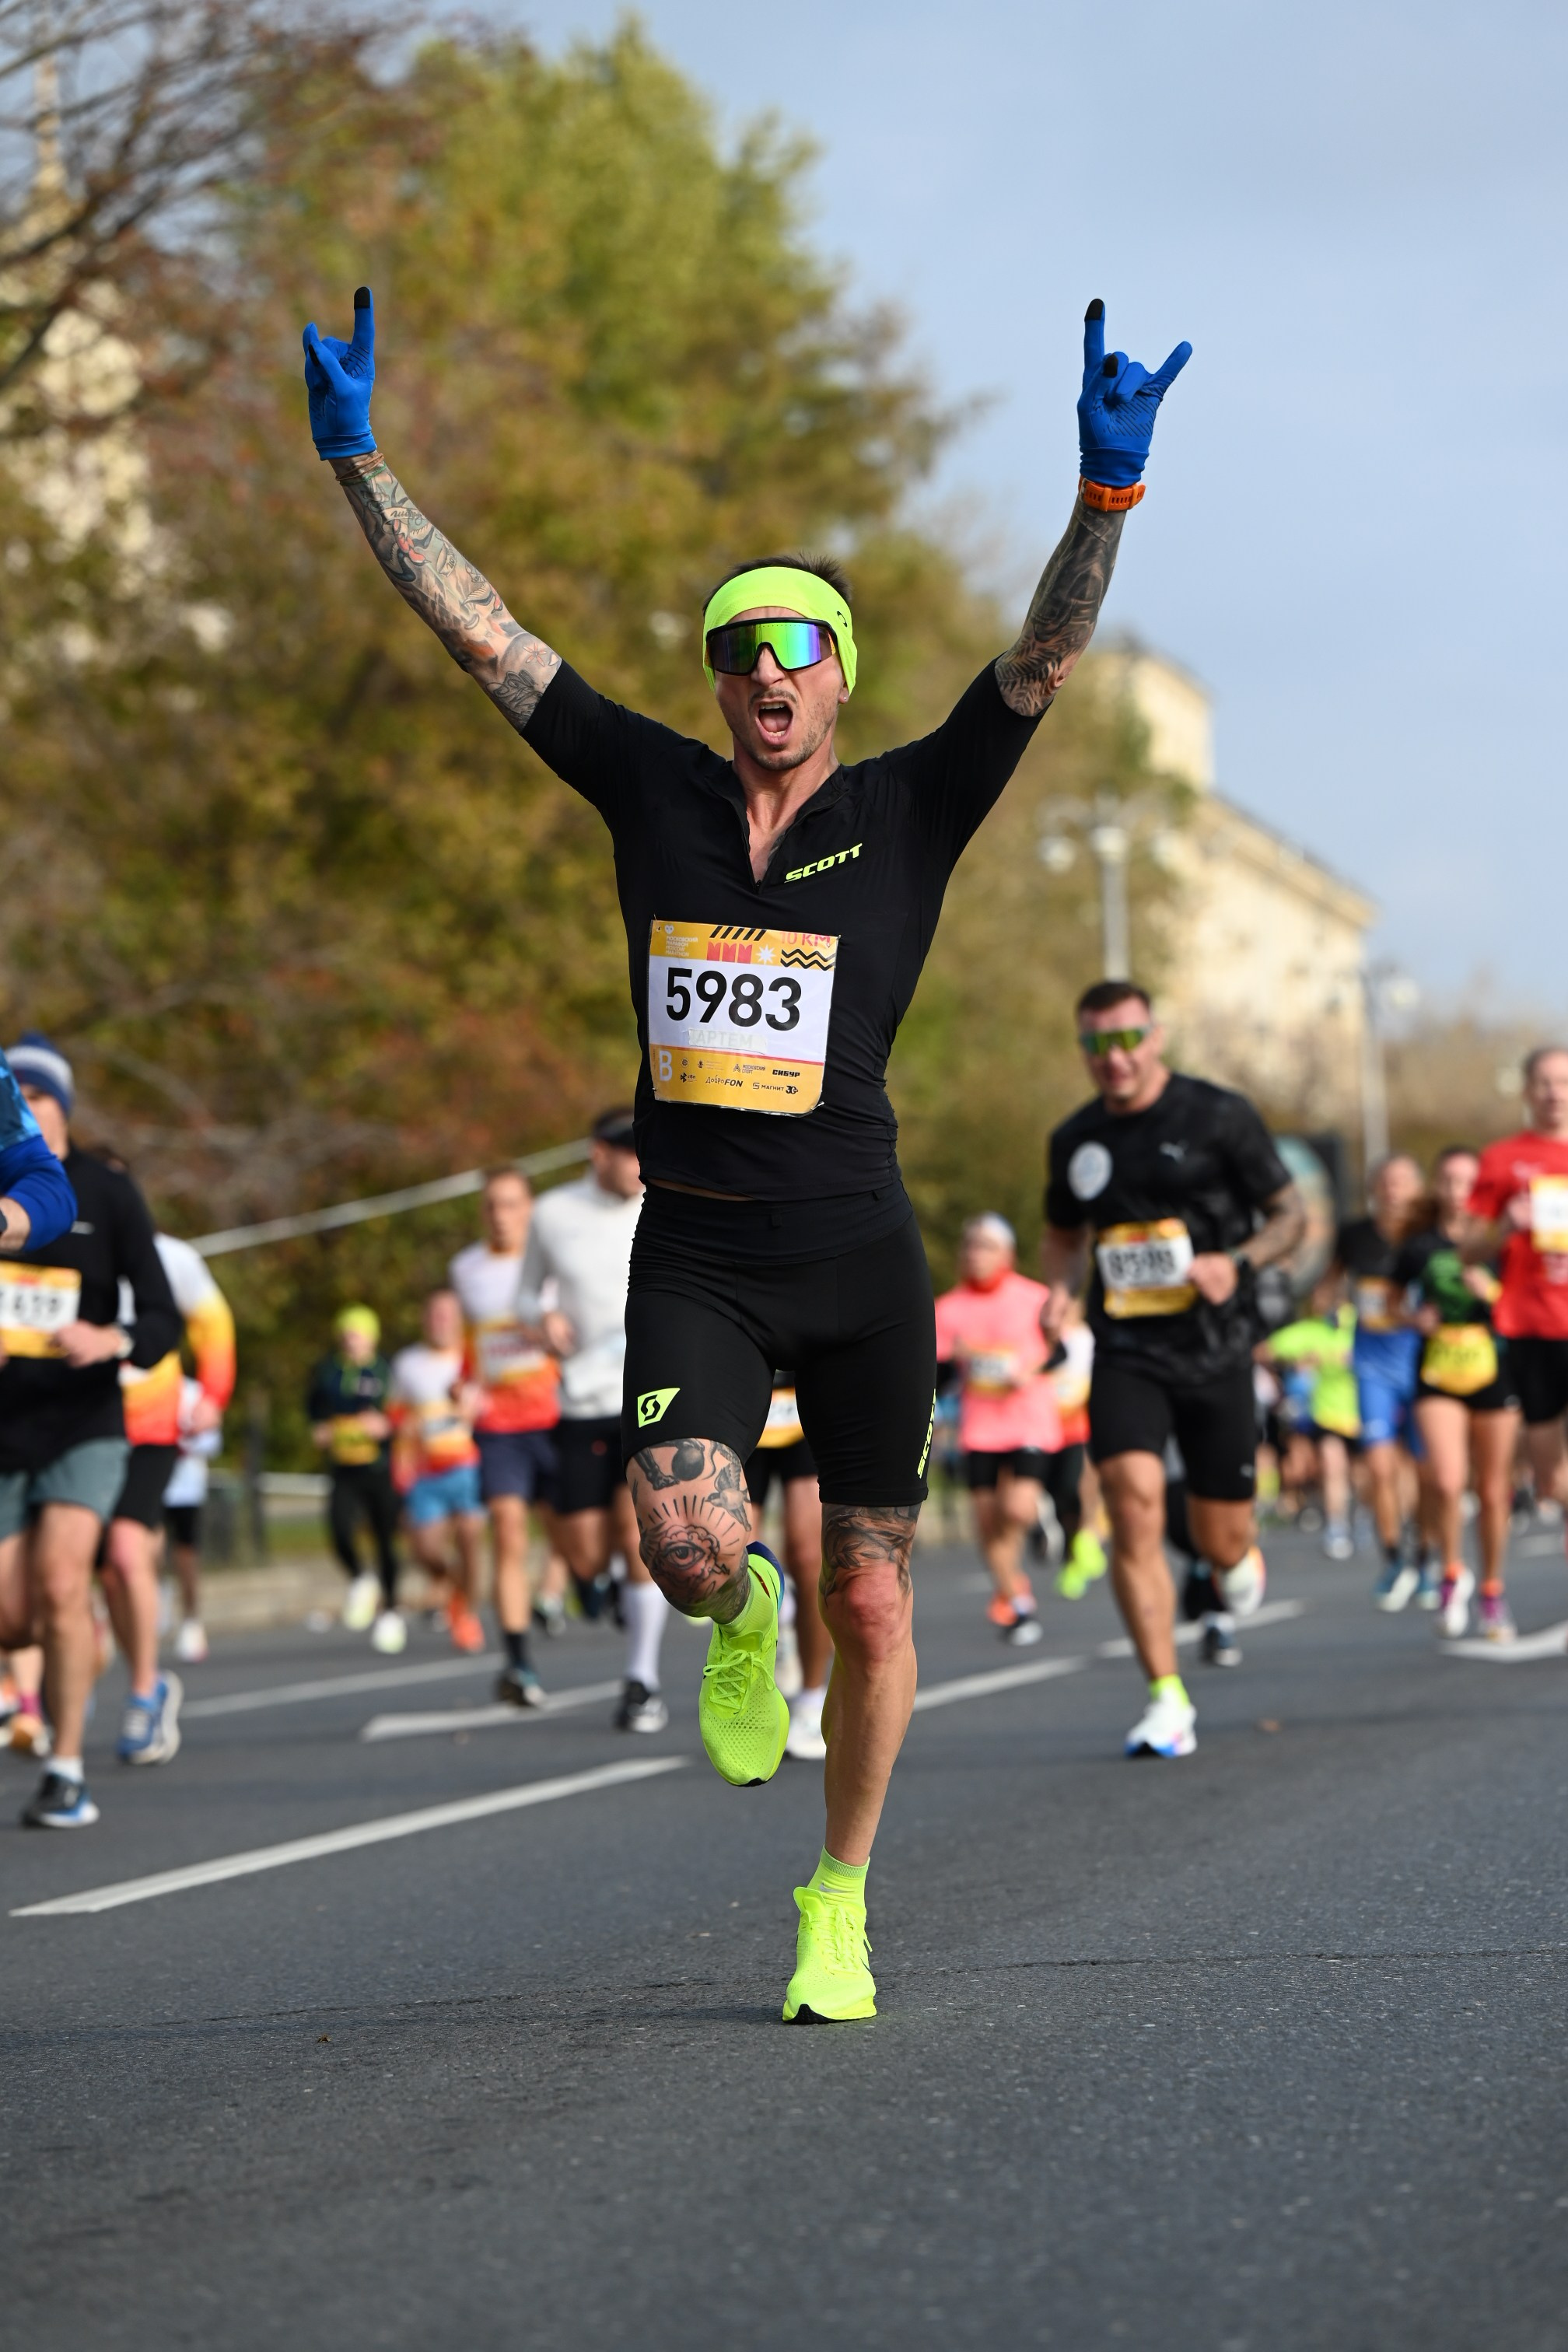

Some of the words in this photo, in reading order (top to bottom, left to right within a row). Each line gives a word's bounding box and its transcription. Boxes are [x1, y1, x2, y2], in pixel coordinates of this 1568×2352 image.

[784, 843, 863, 884] SCOTT
[780, 932, 797, 945] 10
[666, 967, 802, 1031] 5983
[772, 1069, 800, 1078] СИБУР
